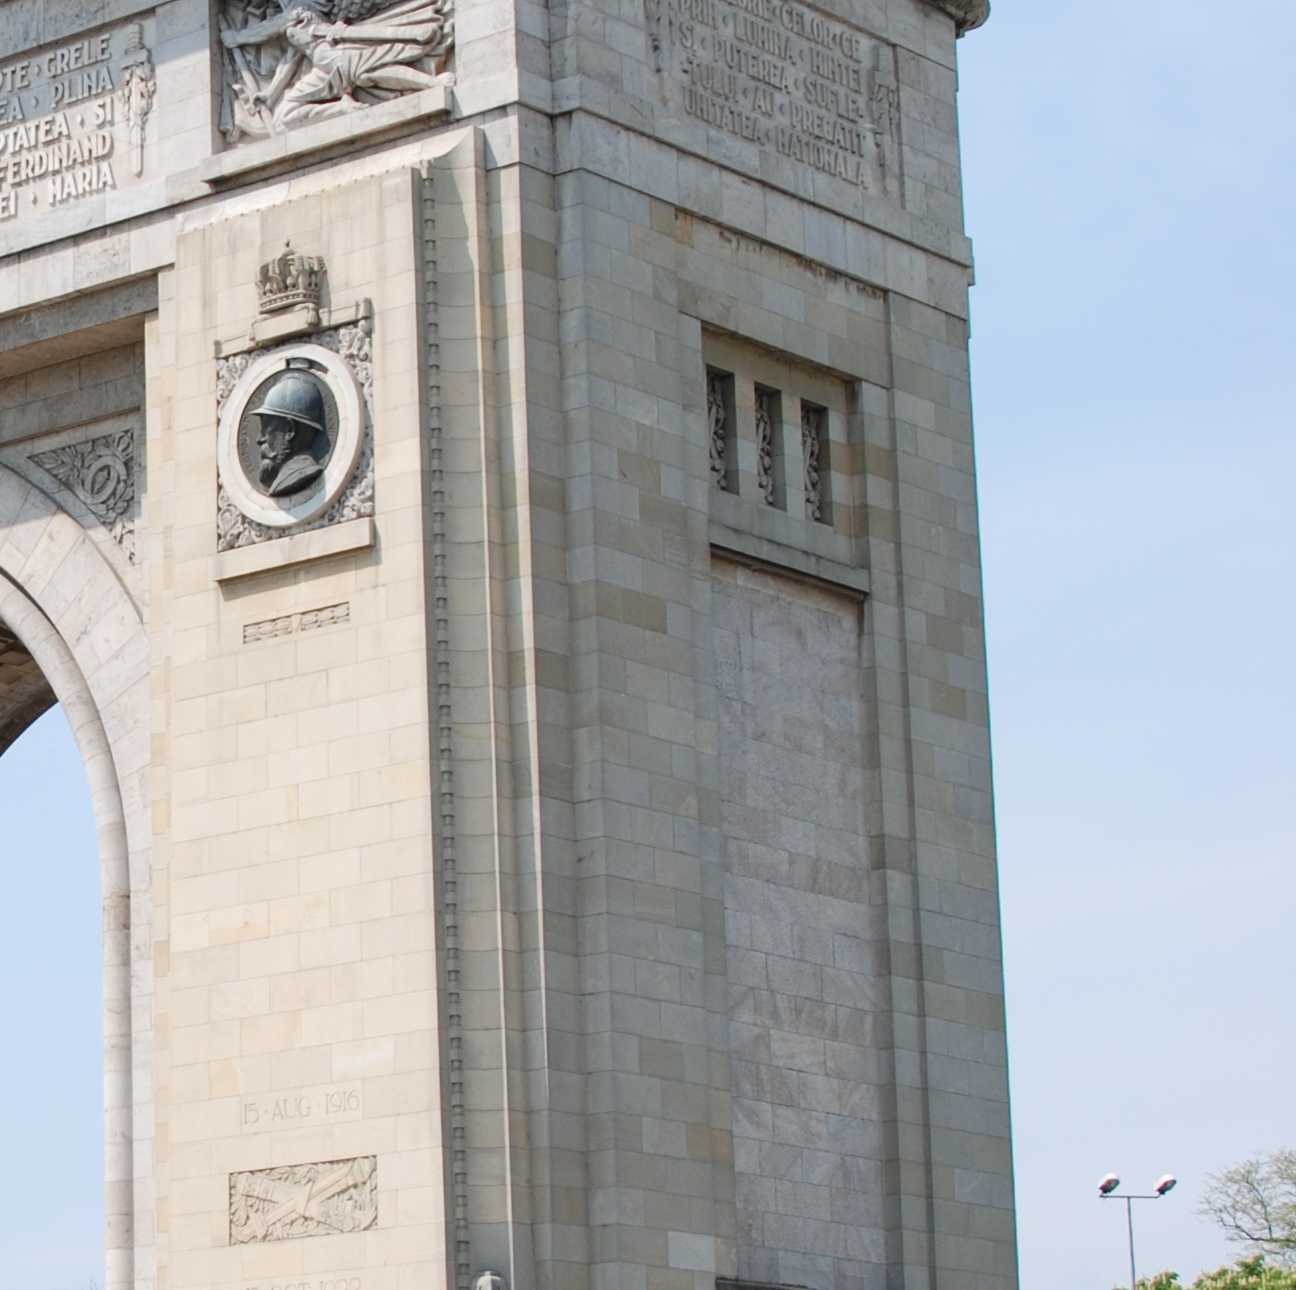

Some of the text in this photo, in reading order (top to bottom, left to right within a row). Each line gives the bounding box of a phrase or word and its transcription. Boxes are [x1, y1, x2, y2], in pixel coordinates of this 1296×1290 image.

[44, 33, 111, 78] GRELE
[679, 21, 696, 53] SI
[712, 35, 792, 95] PUTEREA
[733, 13, 797, 66] LUMINA
[810, 45, 863, 95] MINTEI
[779, 3, 834, 51] CELOR
[840, 30, 862, 63] CE
[50, 65, 114, 109] PLINA
[92, 96, 115, 127] SI
[682, 85, 868, 190] UNITATEA NATIONALA
[754, 85, 774, 117] AU
[789, 99, 866, 157] PREGATIT
[48, 162, 116, 205] MARIA
[244, 1090, 360, 1125] 15 AUG 1916
